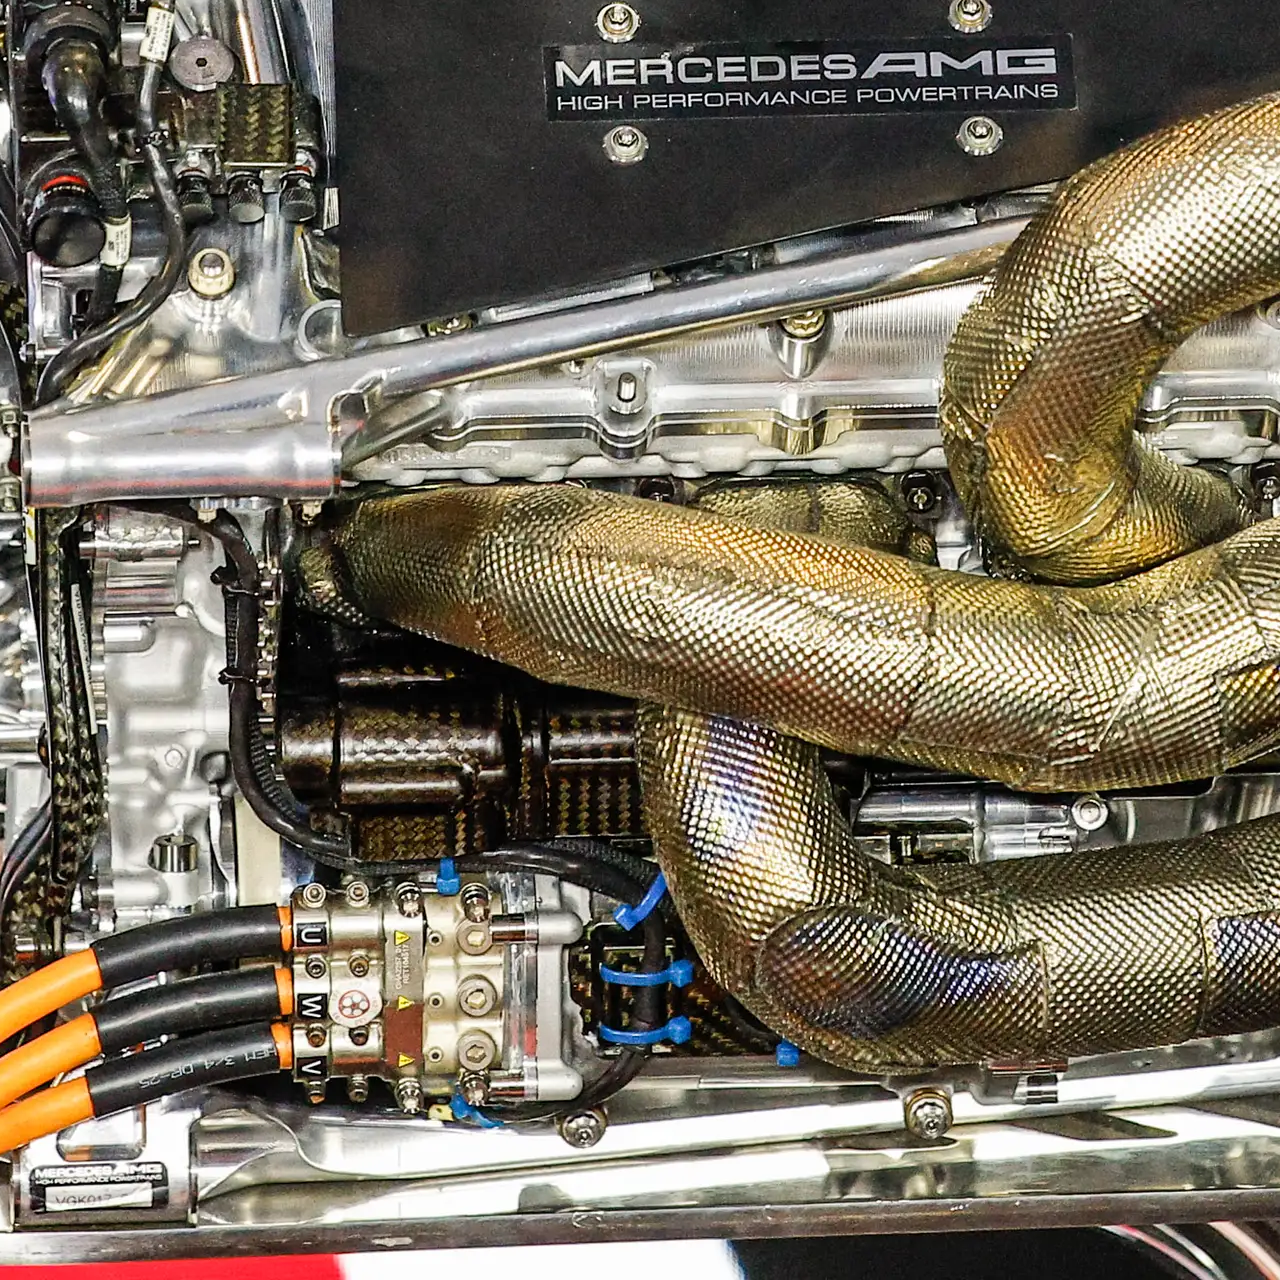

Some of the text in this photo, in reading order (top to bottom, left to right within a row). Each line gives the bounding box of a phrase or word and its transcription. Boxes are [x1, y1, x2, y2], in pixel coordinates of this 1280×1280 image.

[556, 83, 1059, 111] HIGH PERFORMANCE POWERTRAINS
[301, 927, 322, 944] U
[301, 995, 322, 1018] W
[204, 1054, 236, 1070] 3/4
[301, 1060, 322, 1075] V
[54, 1176, 109, 1184] PERFORMANCE
[110, 1174, 163, 1182] POWERTRAINS
